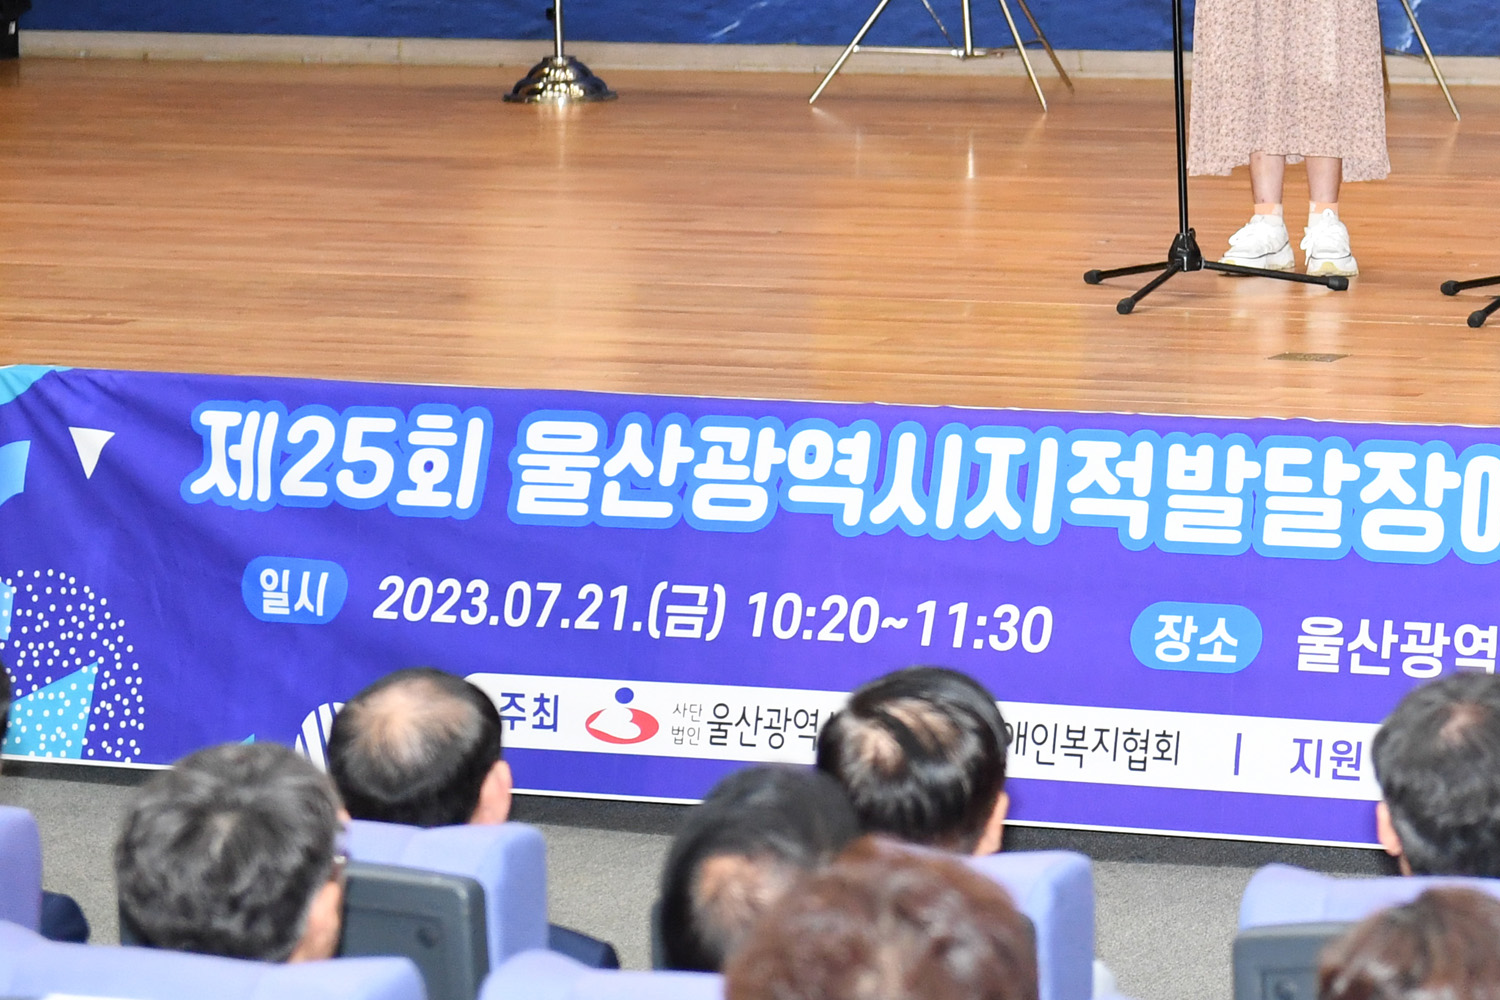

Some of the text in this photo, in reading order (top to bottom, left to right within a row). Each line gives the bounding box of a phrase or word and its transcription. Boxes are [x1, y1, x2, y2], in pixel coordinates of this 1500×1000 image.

[190, 406, 486, 510] 제25회
[258, 566, 1053, 654] 일시 2023.07.21.(금) 10:20~11:30
[1152, 613, 1240, 663] 장소
[499, 691, 560, 733] 주최
[671, 725, 701, 746] 법인
[707, 702, 834, 751] 울산광역
[672, 702, 702, 722] 사단
[1290, 737, 1363, 782] 지원
